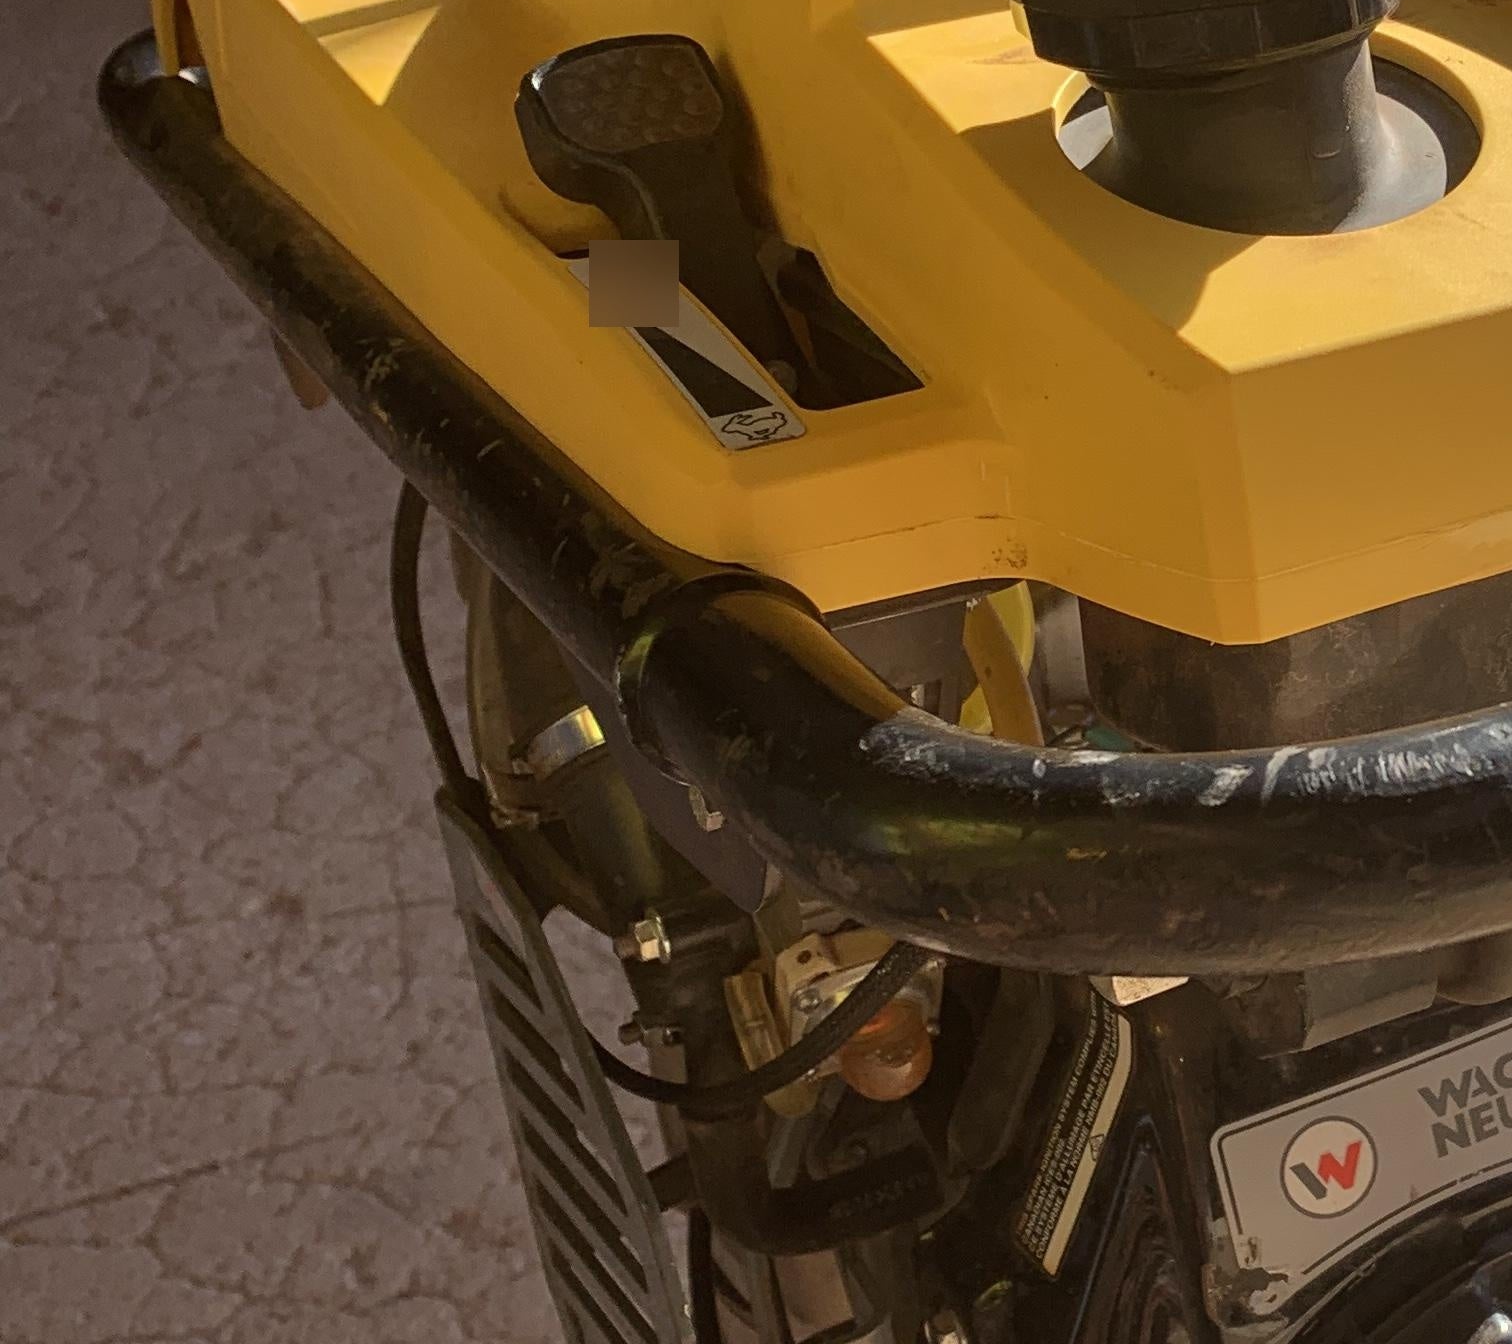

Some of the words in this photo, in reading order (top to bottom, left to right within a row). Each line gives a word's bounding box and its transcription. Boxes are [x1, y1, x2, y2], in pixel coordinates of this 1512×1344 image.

[1058, 1076, 1079, 1121] SYSTEM
[1074, 1019, 1096, 1075] COMPLIES
[1081, 1083, 1095, 1108] PAR
[1035, 1196, 1063, 1259] CONFORME
[1070, 1126, 1089, 1167] NORME
